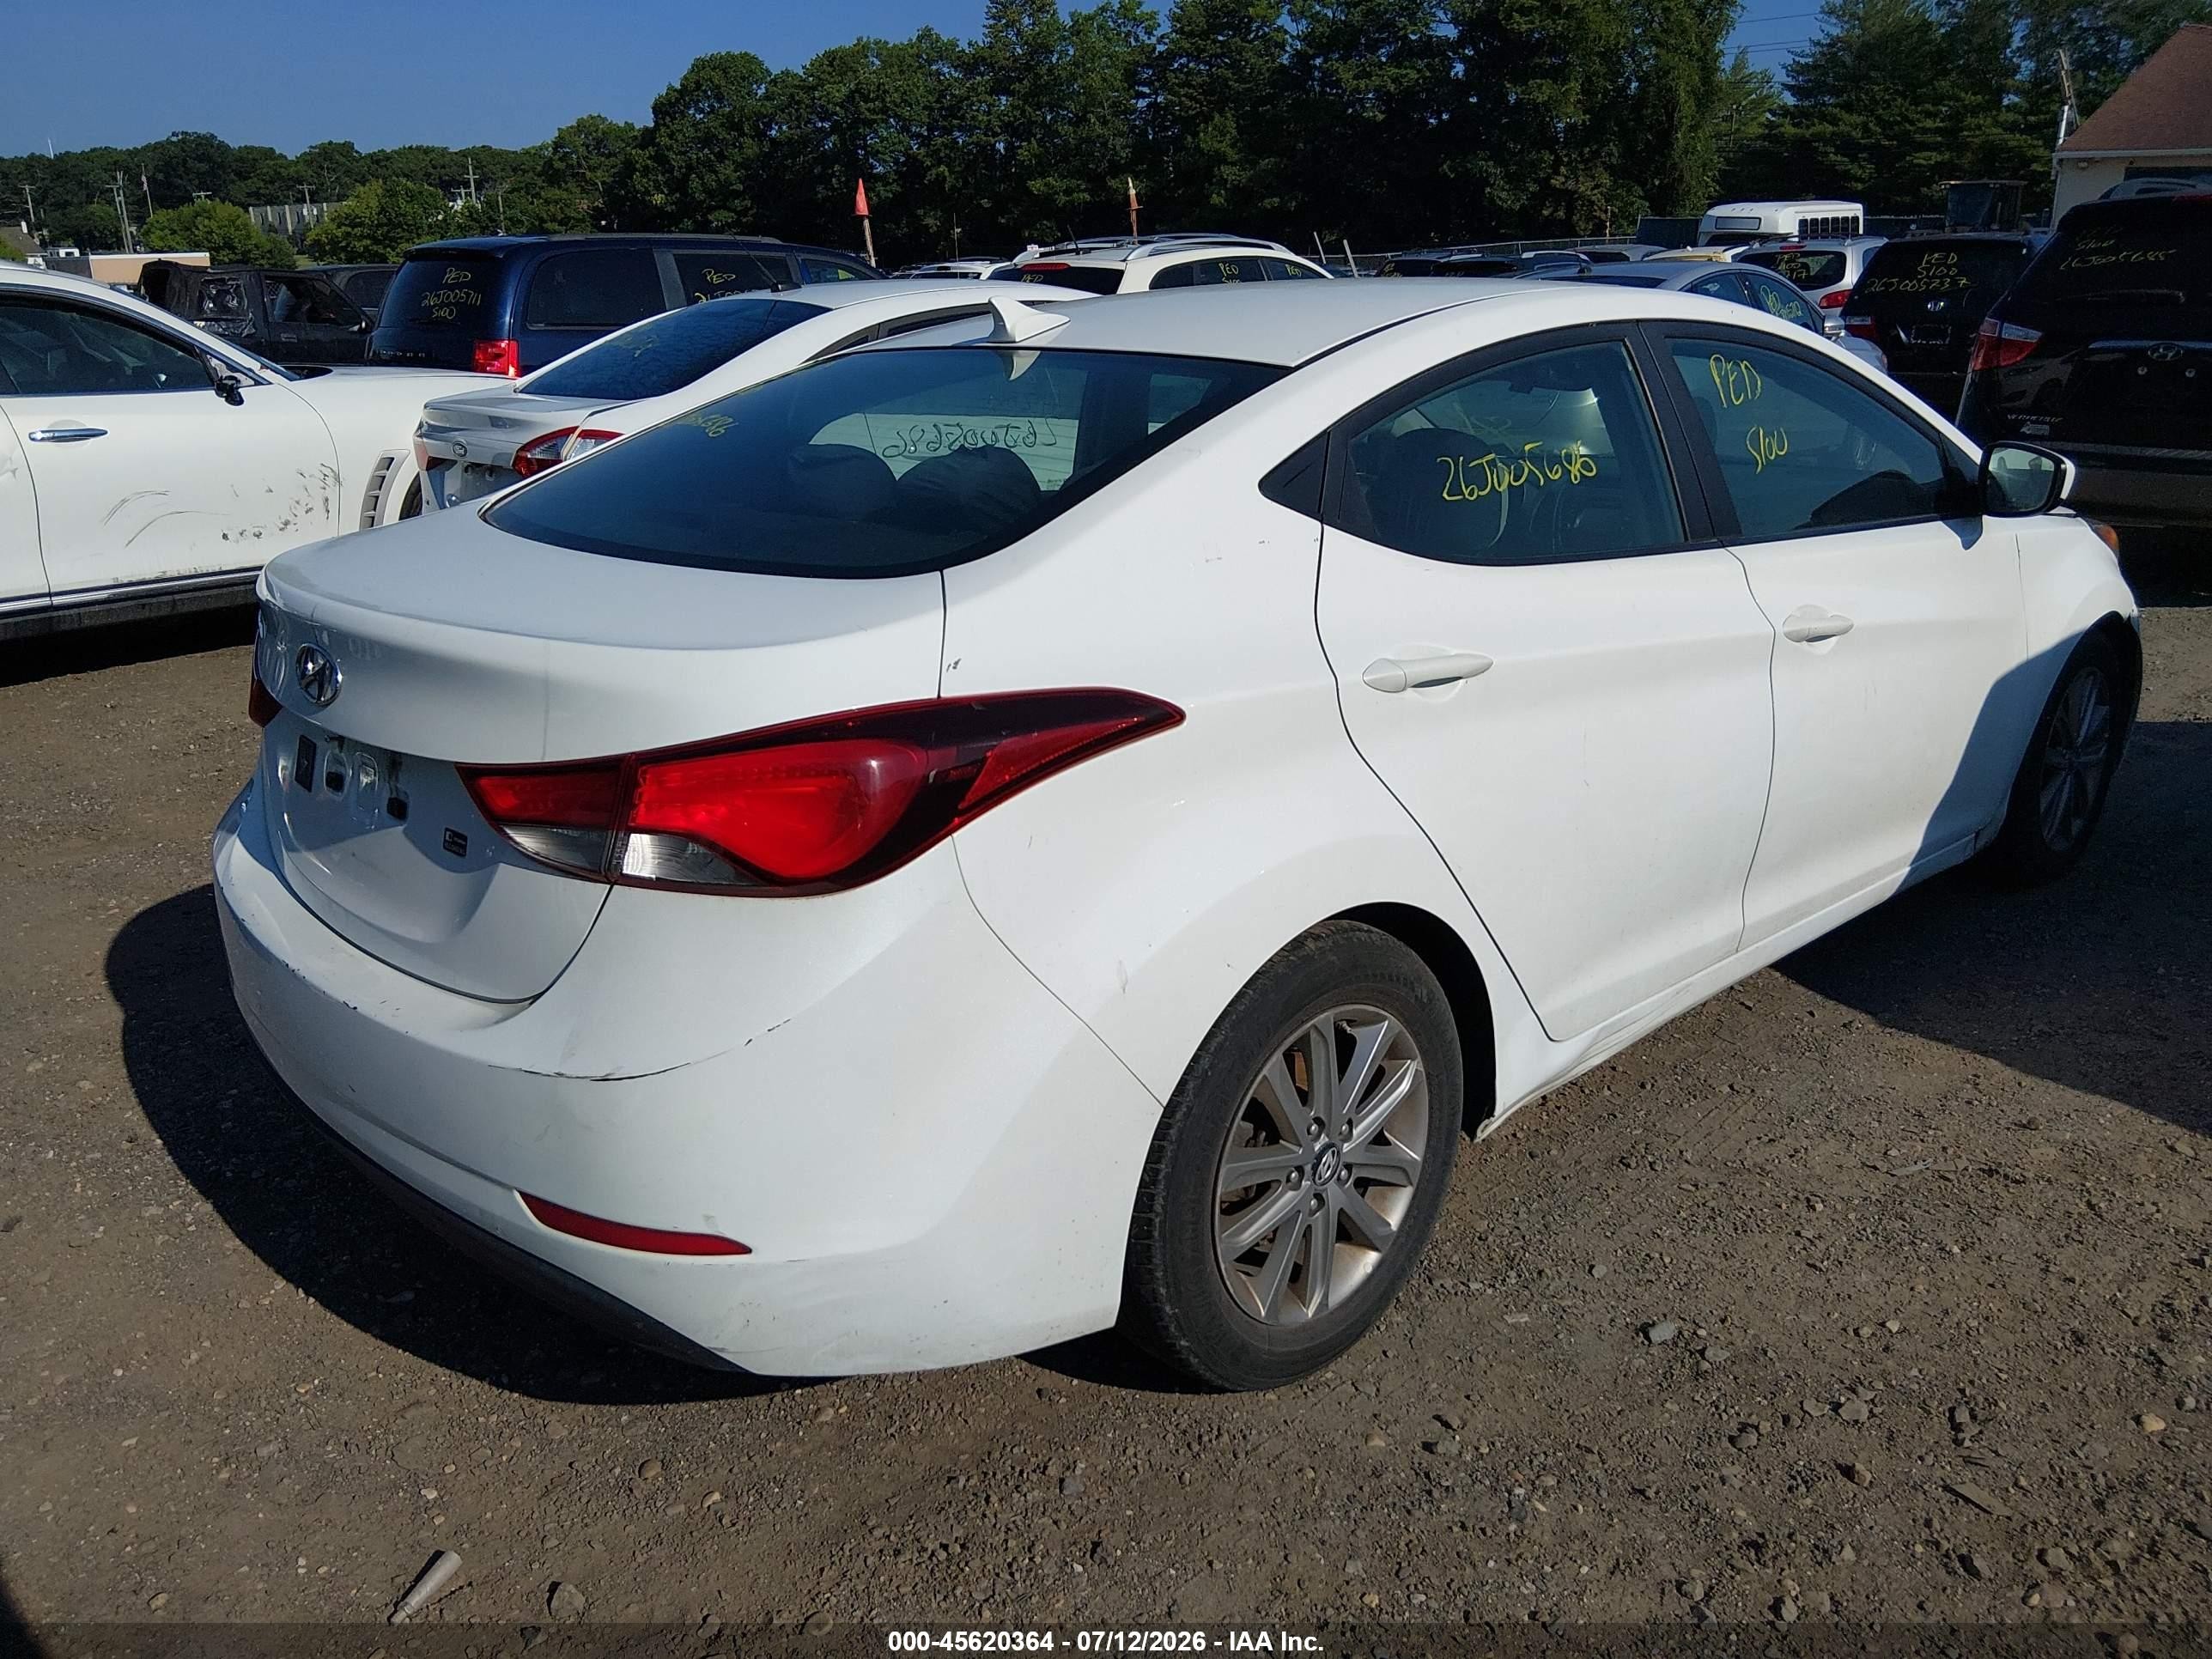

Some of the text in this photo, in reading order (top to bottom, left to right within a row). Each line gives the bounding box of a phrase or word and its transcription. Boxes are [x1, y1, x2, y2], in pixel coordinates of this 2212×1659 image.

[442, 267, 471, 284] PED
[702, 268, 736, 284] PED
[1218, 262, 1239, 276] PED
[1285, 264, 1302, 276] PED
[1917, 265, 1958, 278] S100
[1864, 276, 1972, 294] 26J005737
[421, 289, 482, 307] 26J005711
[432, 306, 456, 319] S100
[1710, 354, 1761, 408] PED
